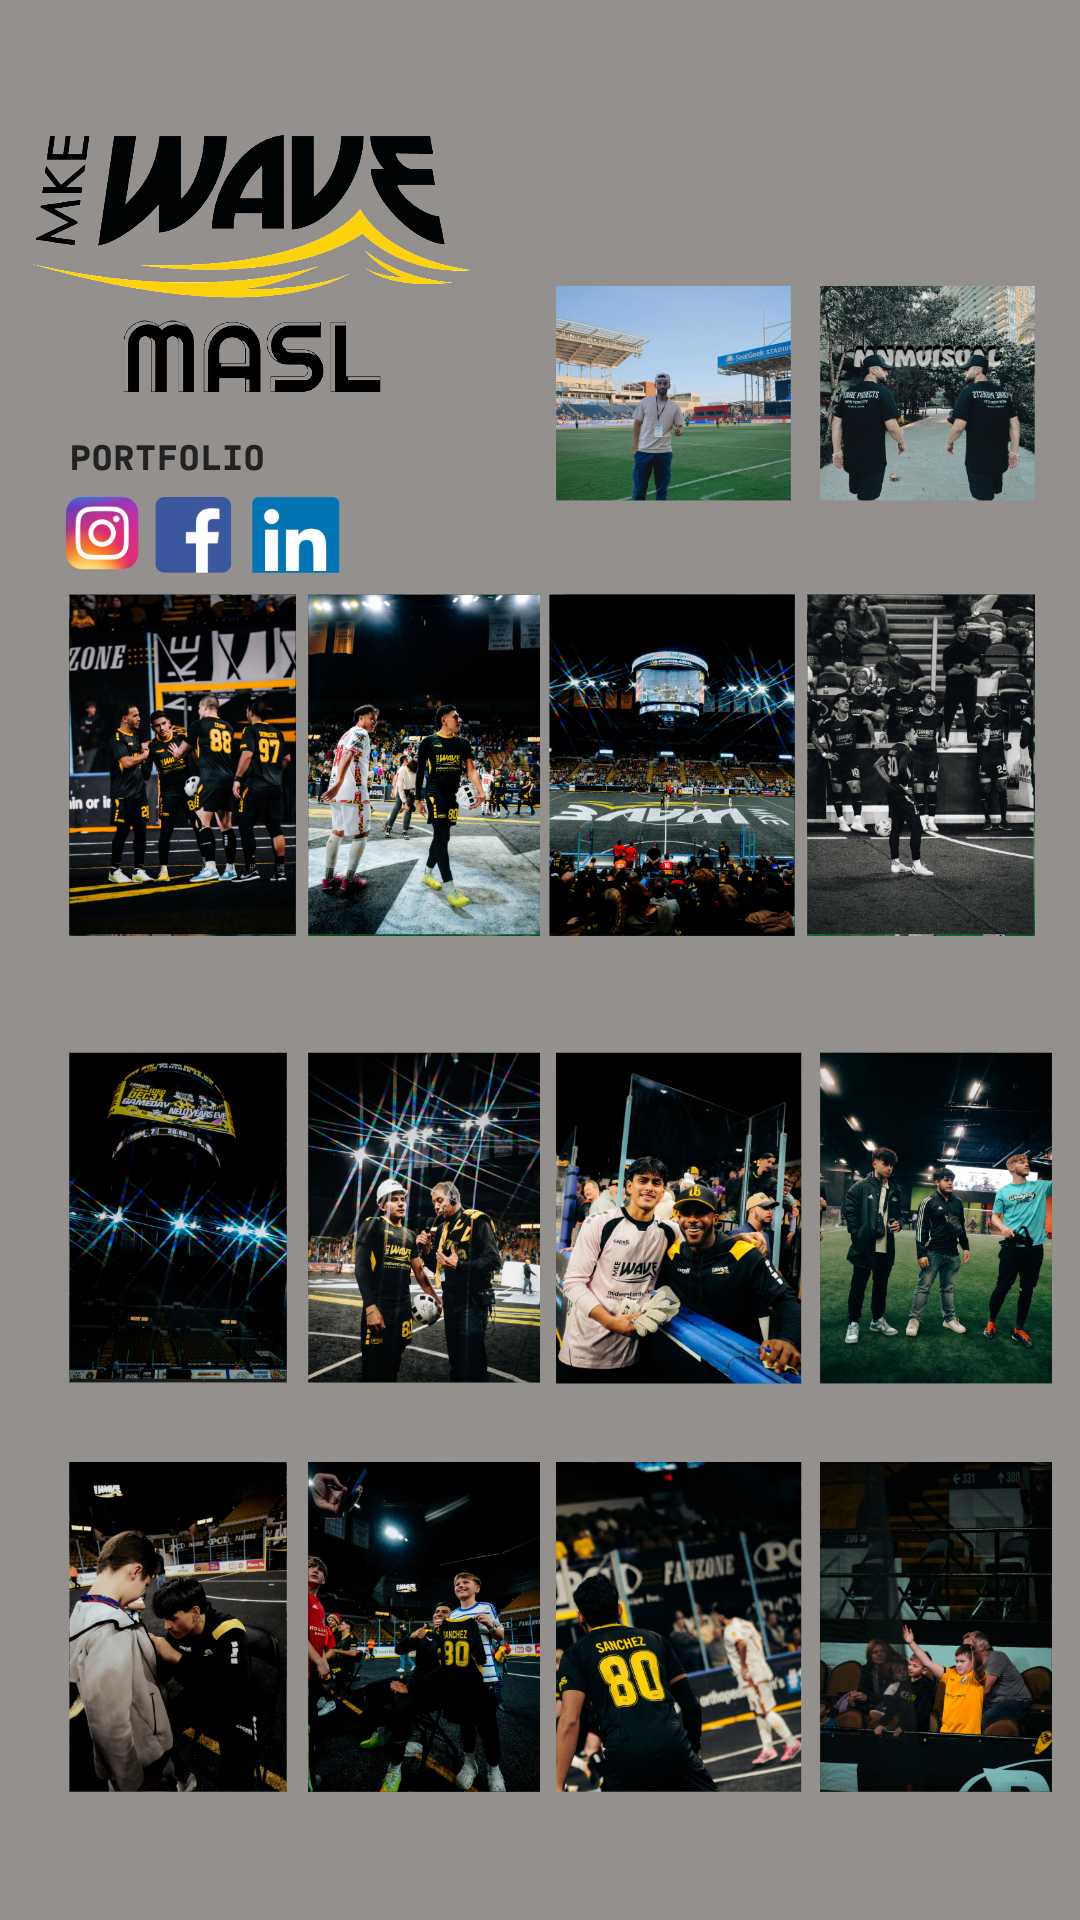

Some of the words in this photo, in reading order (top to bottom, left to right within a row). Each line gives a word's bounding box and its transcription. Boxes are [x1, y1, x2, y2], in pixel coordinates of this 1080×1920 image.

[735, 349, 764, 361] SeatGeek
[209, 728, 232, 754] 88
[258, 738, 281, 764] 97
[86, 797, 100, 809] or
[214, 1112, 227, 1120] EVE
[612, 1261, 621, 1277] MKE
[619, 1261, 658, 1278] WAVE
[962, 1472, 976, 1484] 331
[1006, 1471, 1020, 1484] 300
[663, 1553, 736, 1587] FANZONE
[443, 1630, 468, 1640] SANCHEZ
[595, 1636, 647, 1655] SANCHEZ
[598, 1649, 666, 1709] 80
